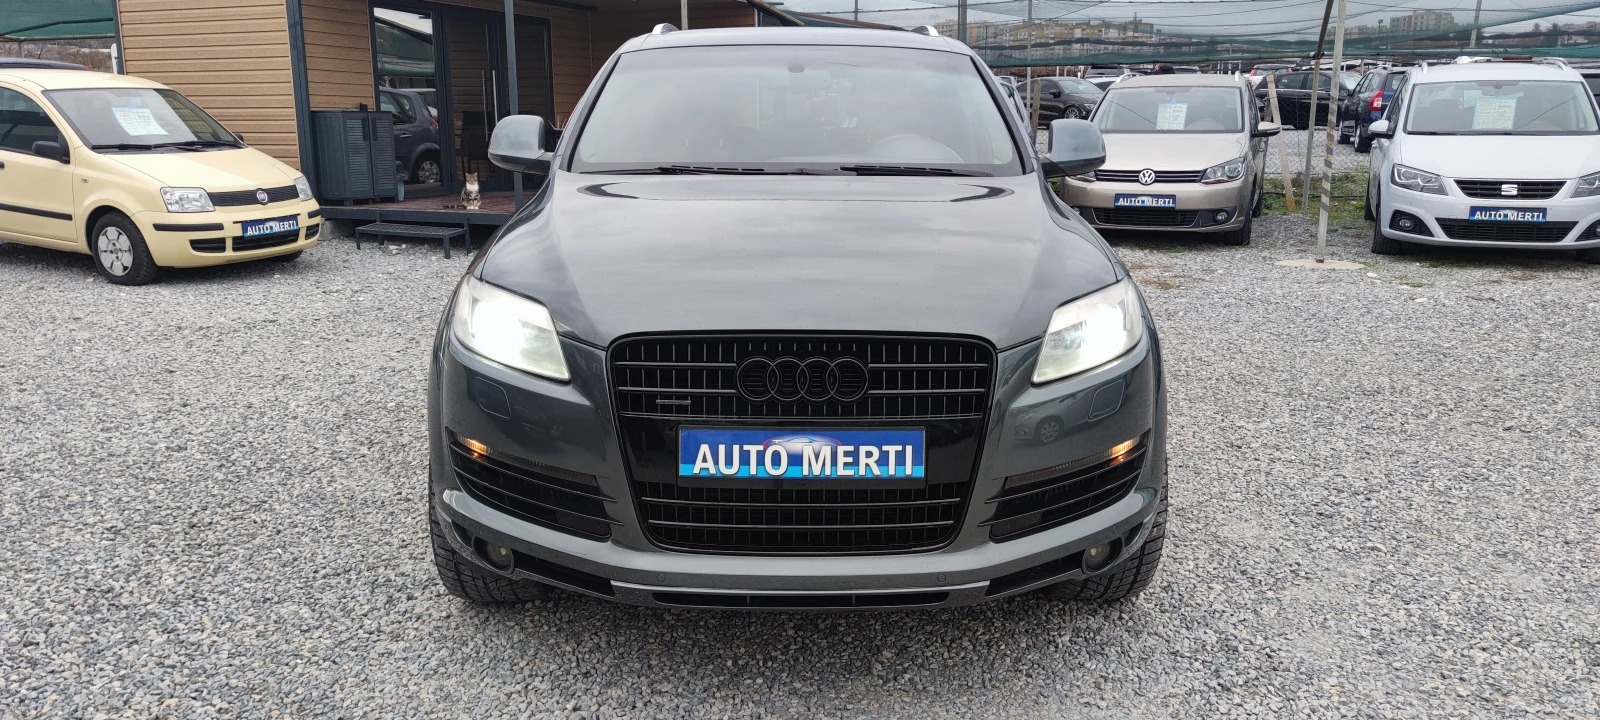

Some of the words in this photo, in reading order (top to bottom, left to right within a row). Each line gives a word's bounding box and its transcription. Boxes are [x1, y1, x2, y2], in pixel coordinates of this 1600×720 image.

[1118, 197, 1142, 206] AUTO
[1144, 198, 1173, 207] MERTI
[1474, 210, 1504, 220] AUTO
[1507, 211, 1543, 222] MERTI
[247, 224, 270, 236] AUTO
[272, 220, 297, 233] MERTI
[692, 443, 788, 476] AUTO
[802, 444, 913, 477] MERTI
